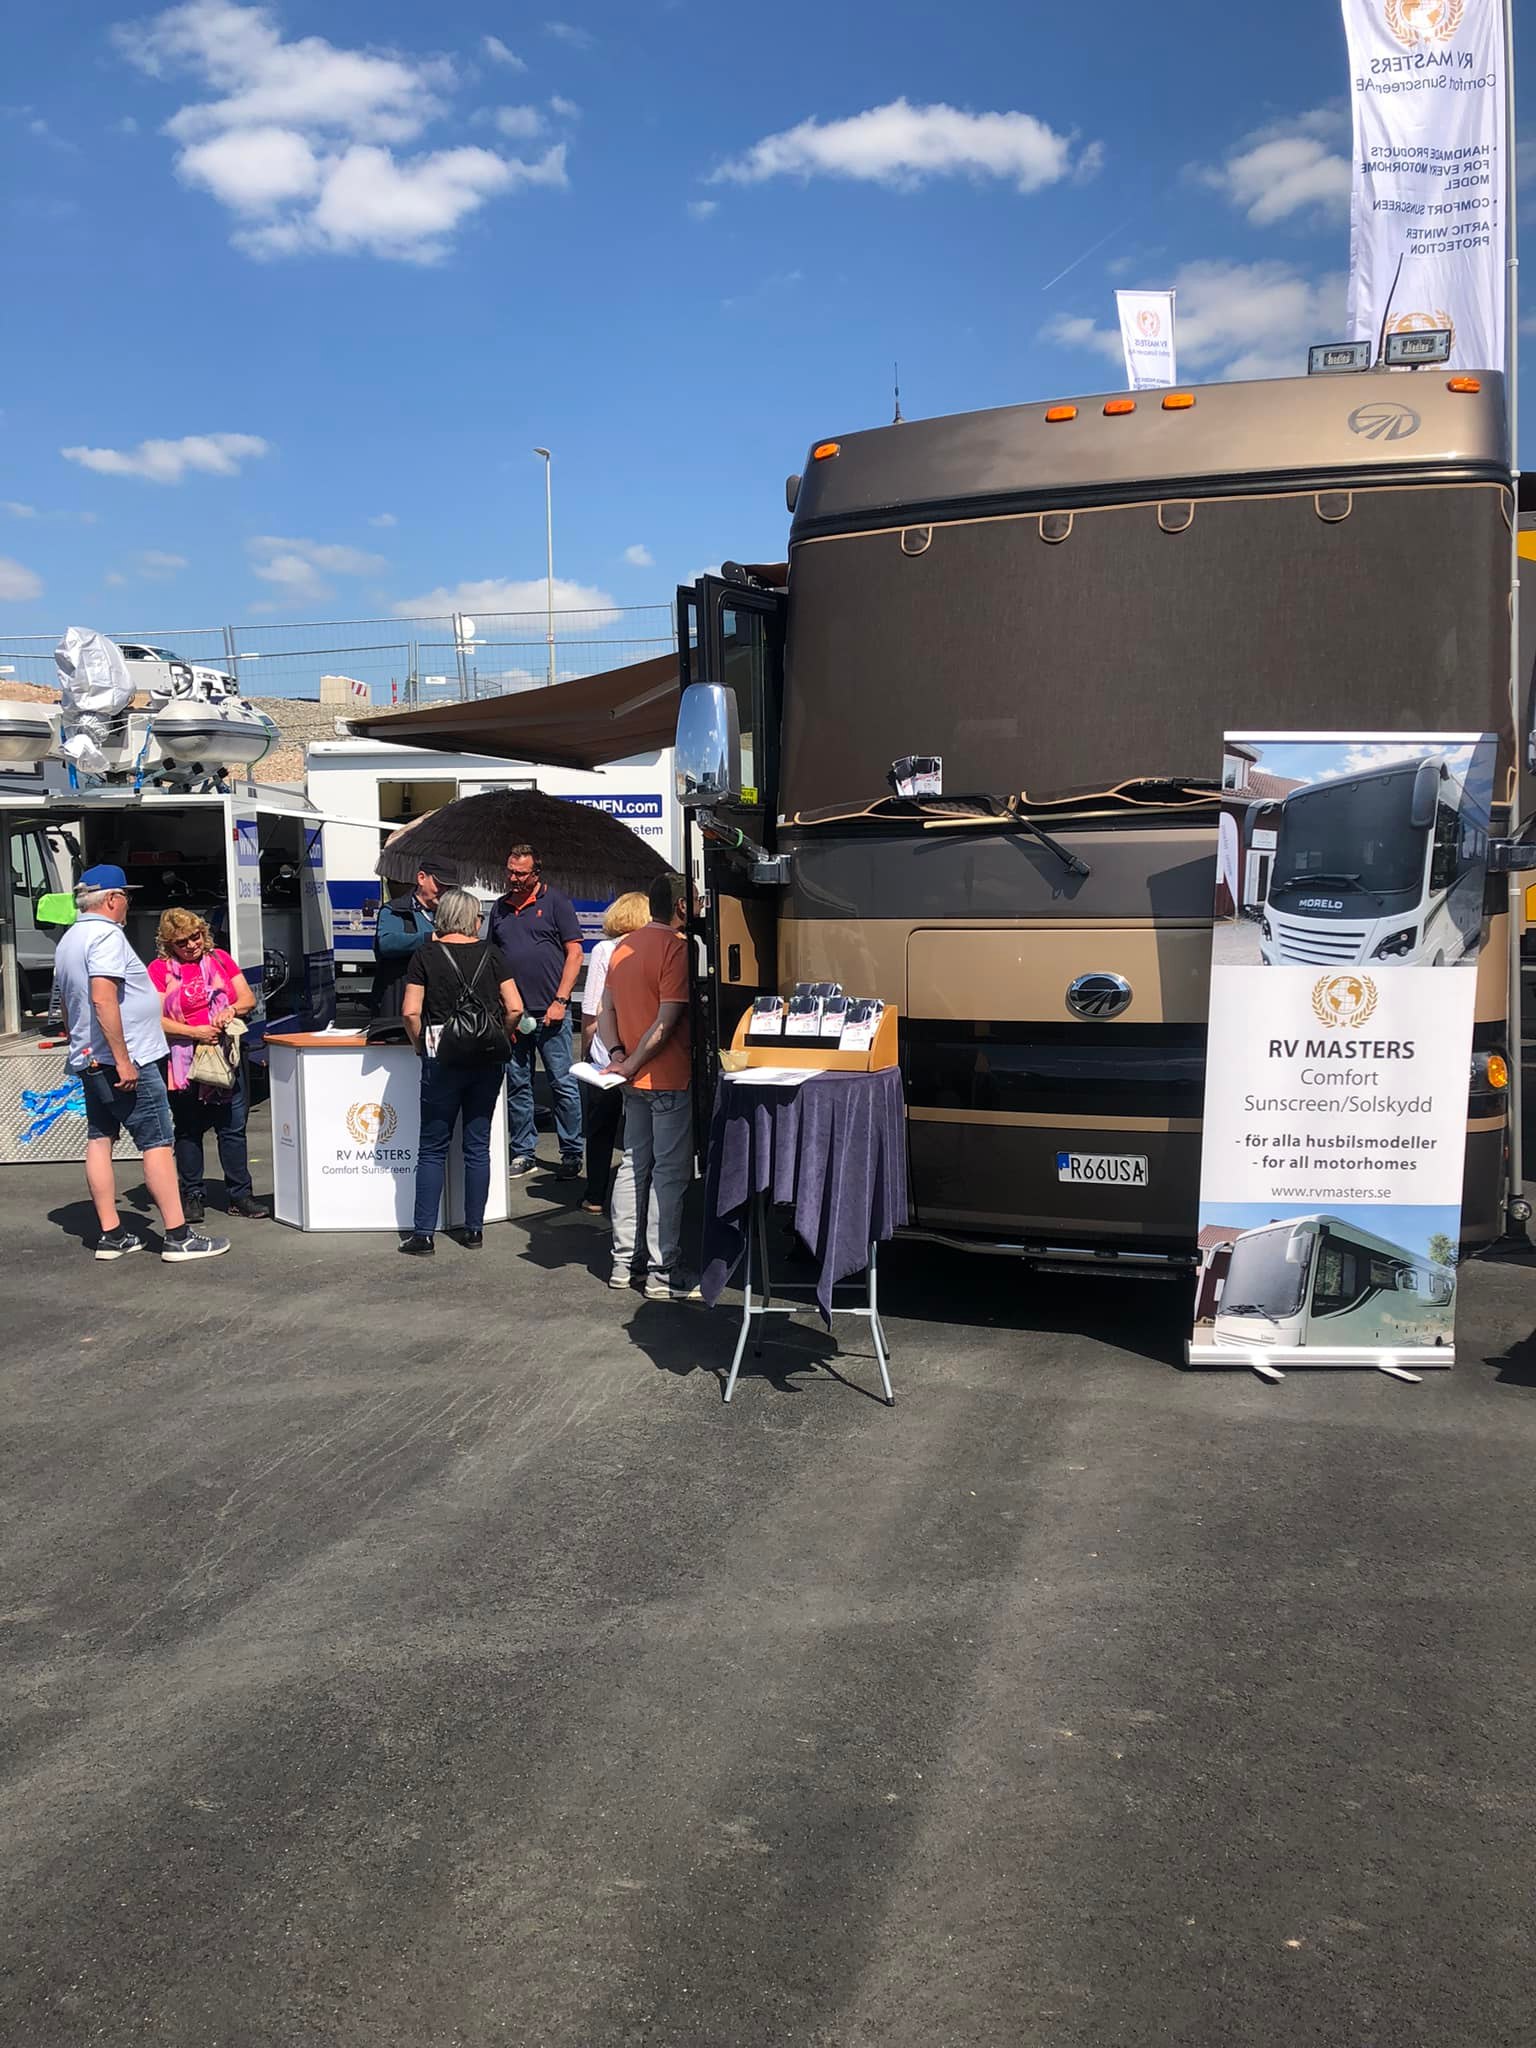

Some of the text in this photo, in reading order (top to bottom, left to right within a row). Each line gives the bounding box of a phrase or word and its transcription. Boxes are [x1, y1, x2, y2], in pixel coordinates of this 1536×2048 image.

[1298, 898, 1344, 909] MORELO
[1268, 1039, 1415, 1059] RV MASTERS
[1300, 1068, 1379, 1086] Comfort
[1244, 1094, 1433, 1117] Sunscreen/Solskydd
[1245, 1133, 1268, 1148] för
[1272, 1134, 1301, 1148] alla
[1306, 1134, 1437, 1149] husbilsmodeller
[336, 1149, 412, 1161] RV MASTERS
[1262, 1155, 1285, 1169] for
[1289, 1155, 1309, 1169] all
[1313, 1156, 1417, 1170] motorhomes
[321, 1164, 359, 1175] Comfort
[361, 1164, 411, 1175] Sunscreen
[1070, 1157, 1144, 1182] R66USA
[1271, 1187, 1392, 1199] www.rvmasters.se
